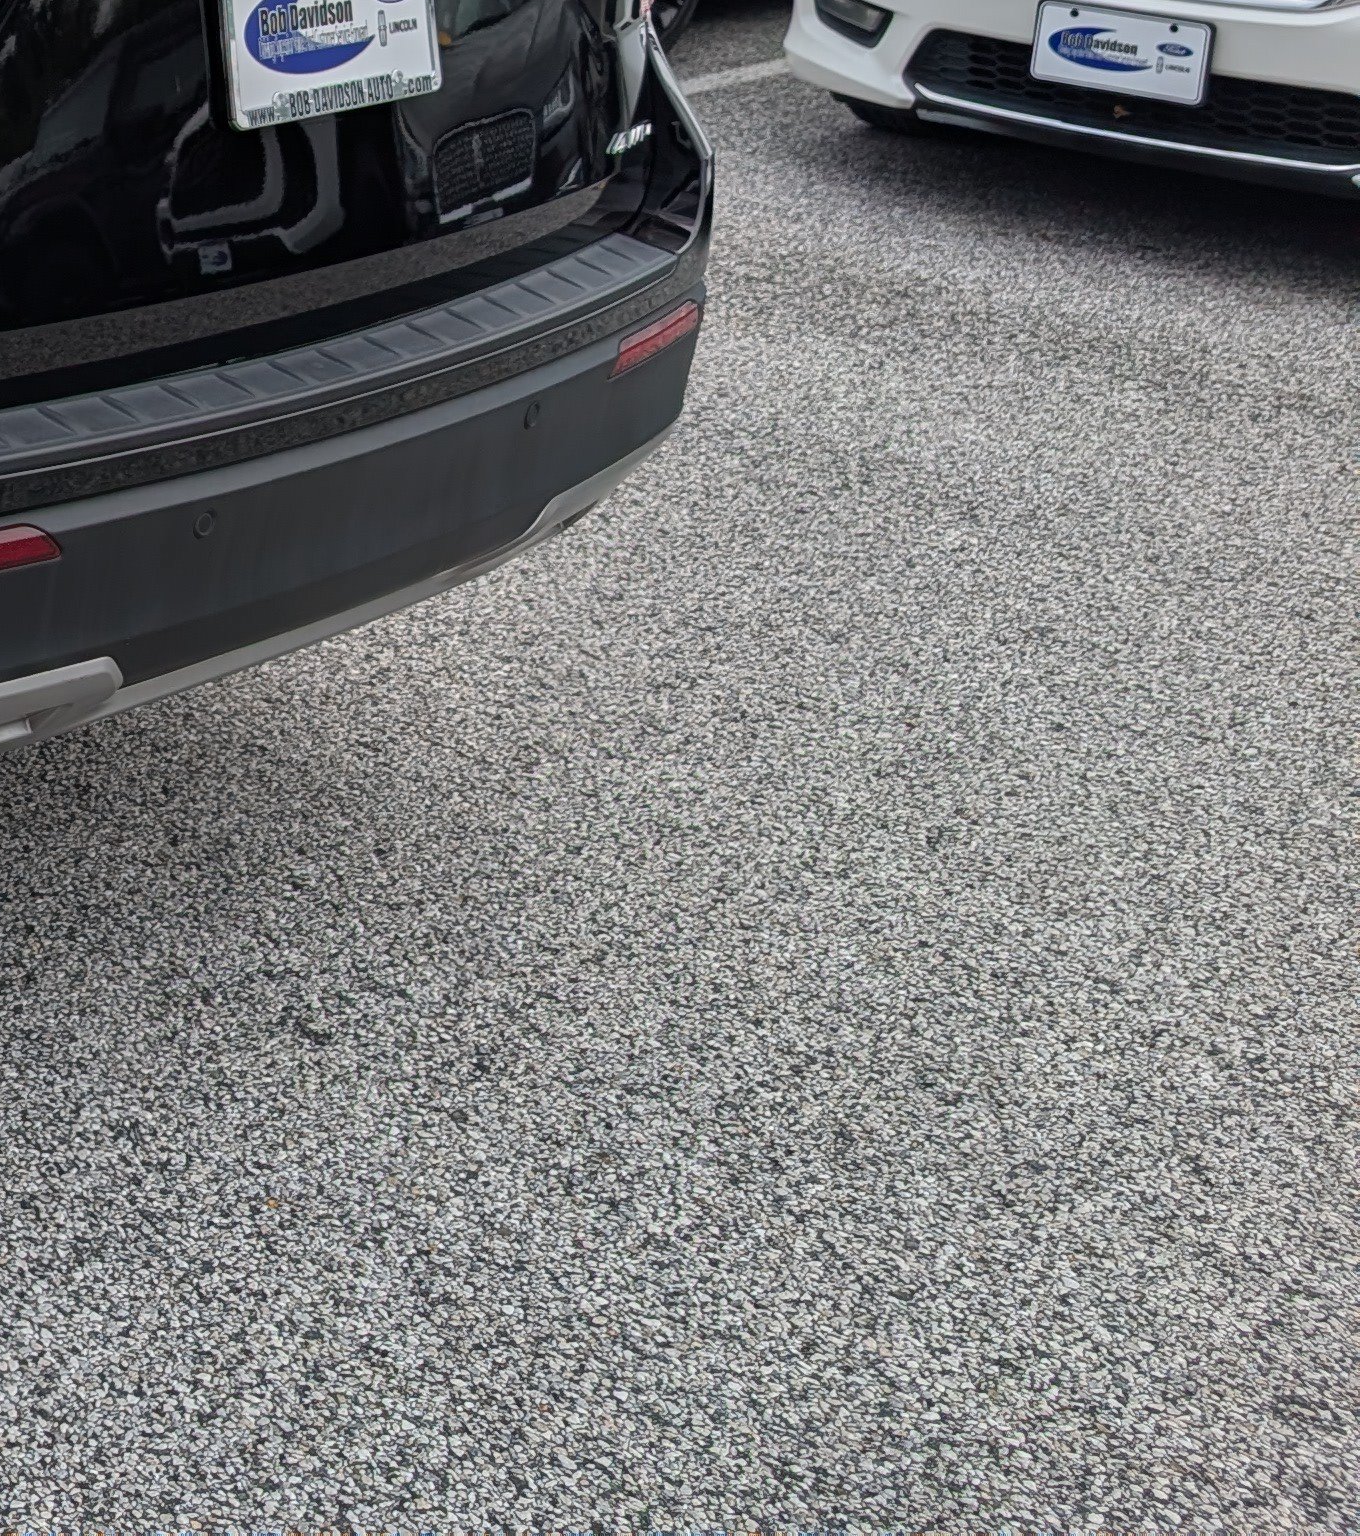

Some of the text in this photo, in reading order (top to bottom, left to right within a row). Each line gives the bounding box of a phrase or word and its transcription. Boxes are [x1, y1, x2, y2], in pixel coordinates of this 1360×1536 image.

[259, 0, 354, 36] Bob Davidson
[388, 18, 418, 34] LINCOLN
[1062, 31, 1138, 55] Bob Davidson
[289, 92, 311, 117] BOB
[312, 80, 363, 112] DAVIDSON
[366, 74, 394, 101] AUTO
